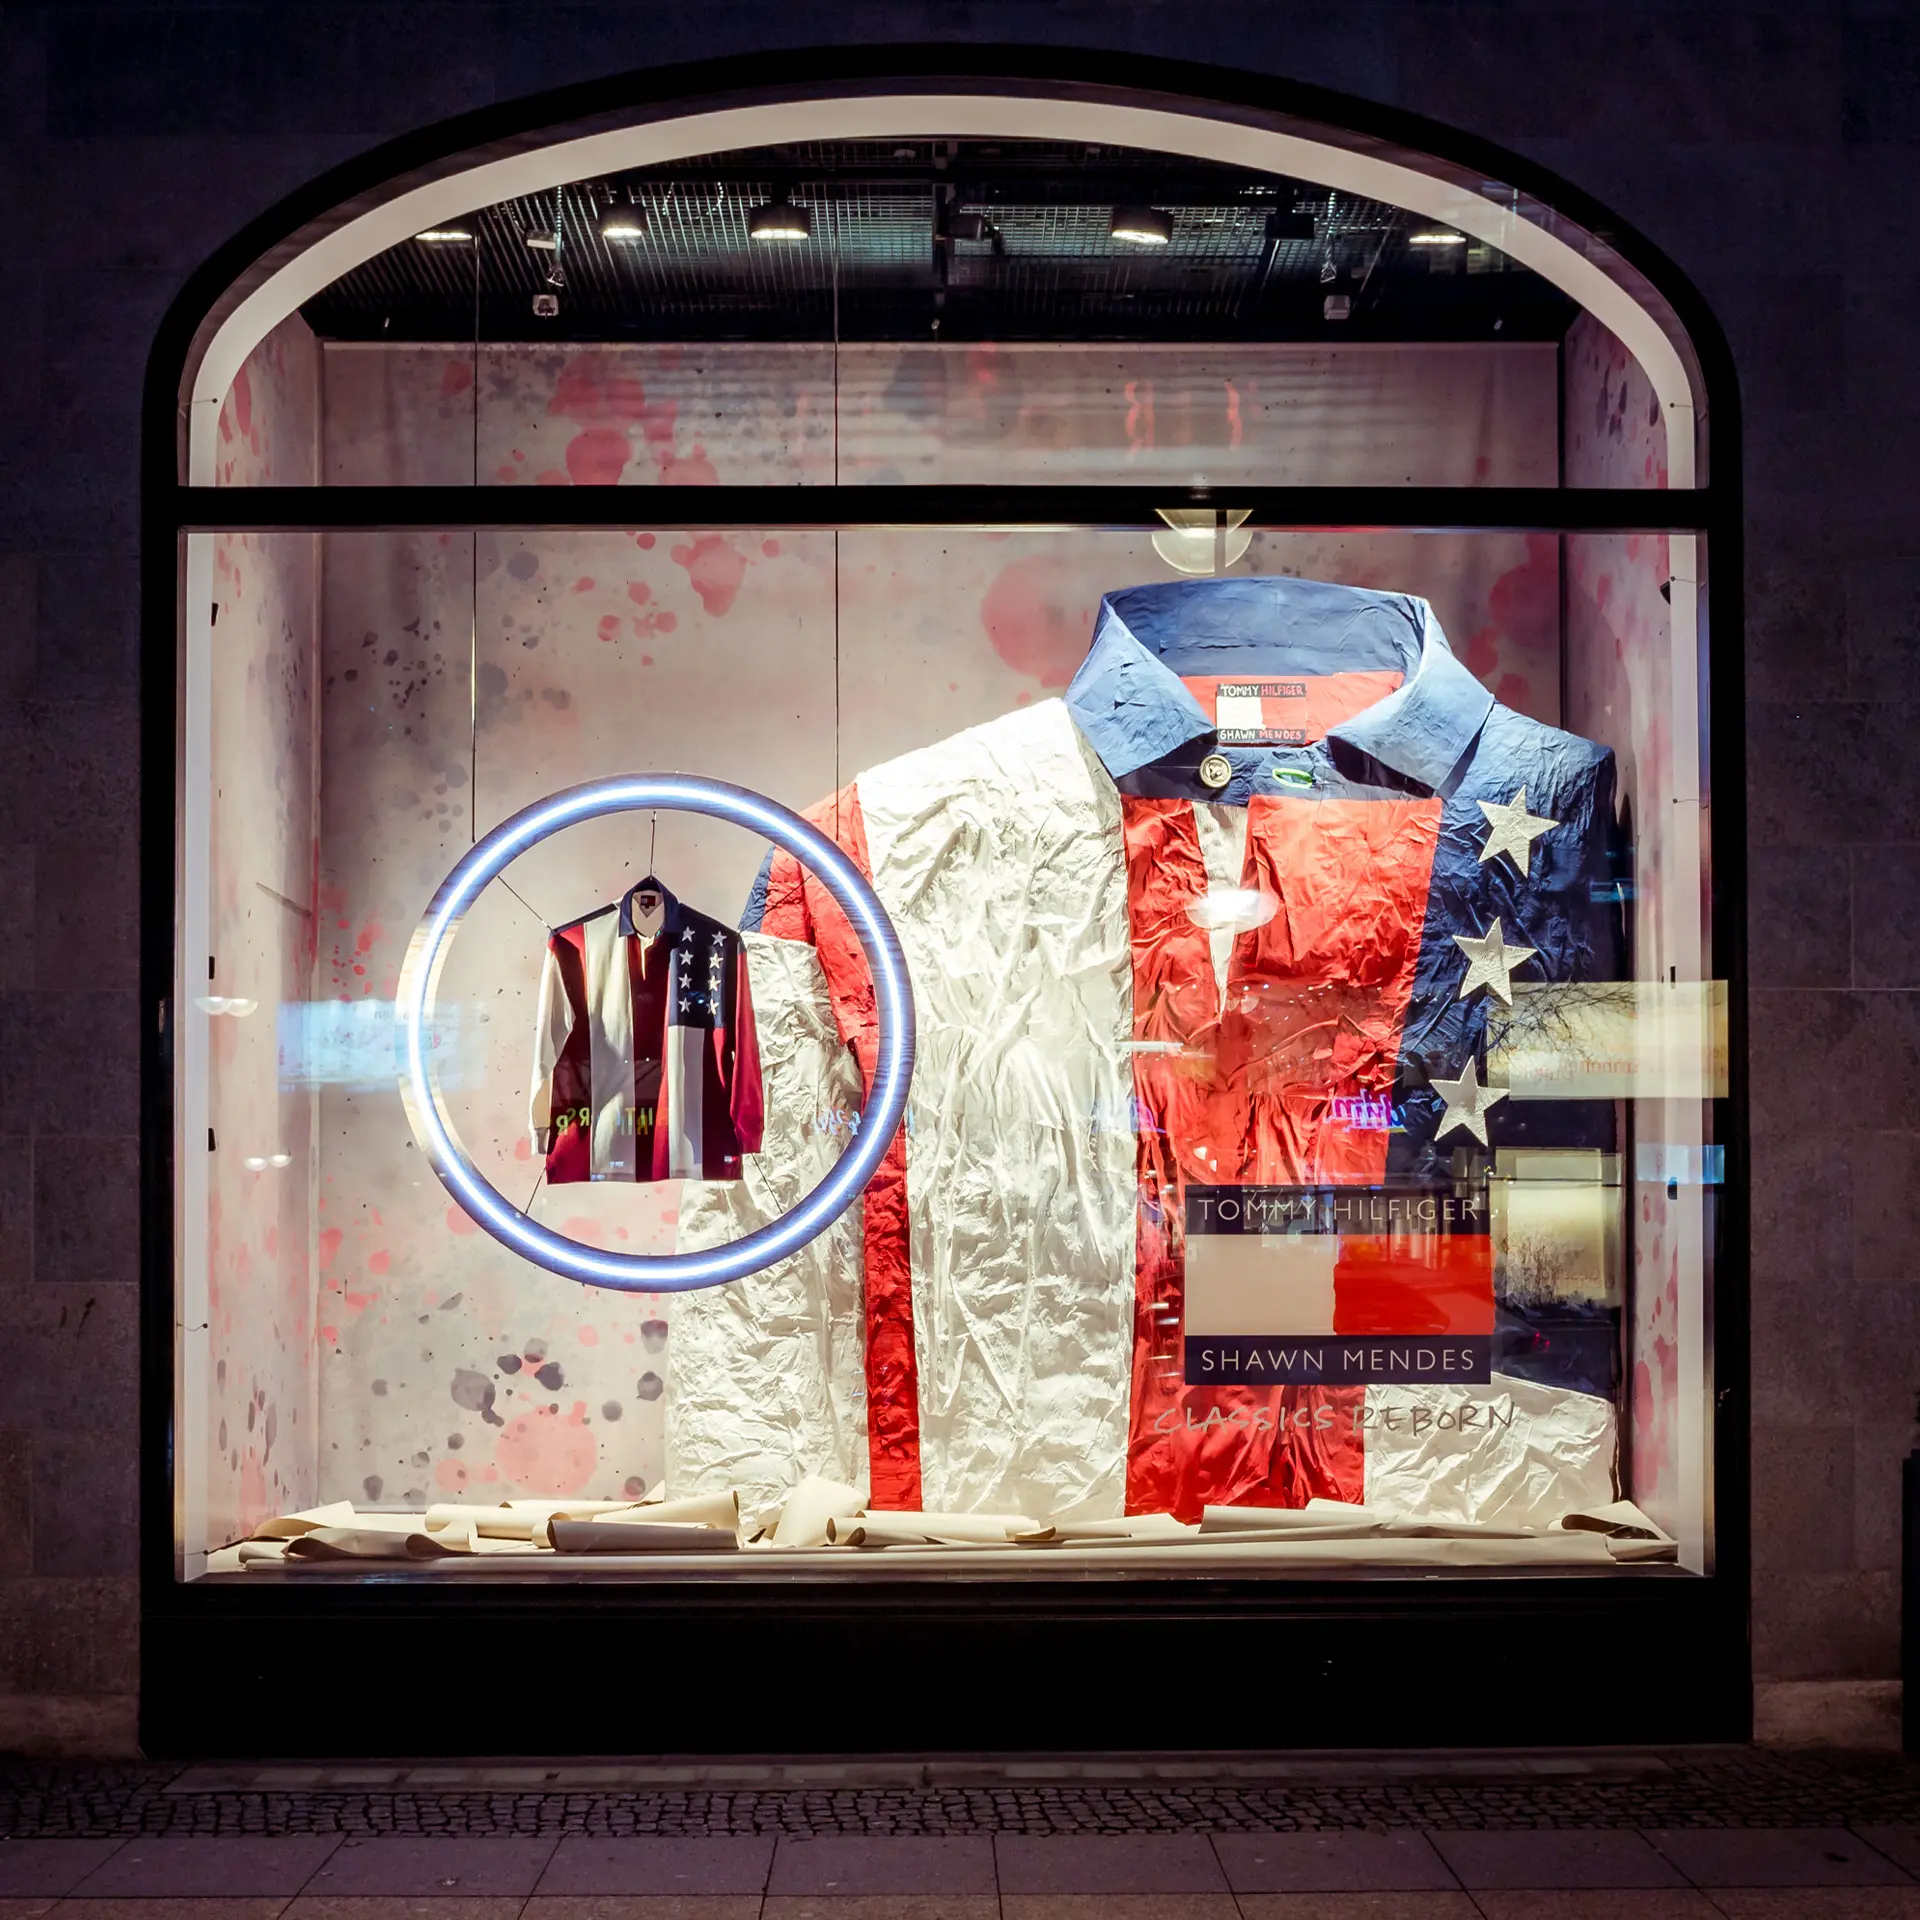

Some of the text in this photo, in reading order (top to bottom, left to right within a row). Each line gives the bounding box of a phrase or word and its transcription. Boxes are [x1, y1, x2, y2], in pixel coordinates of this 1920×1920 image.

[1220, 685, 1304, 696] TOMMY HILFIGER
[1220, 730, 1302, 740] SHAWN MENDES
[1197, 1199, 1479, 1221] TOMMY HILFIGER
[1201, 1349, 1475, 1372] SHAWN MENDES
[1153, 1401, 1516, 1437] CLASSICS REBORN
